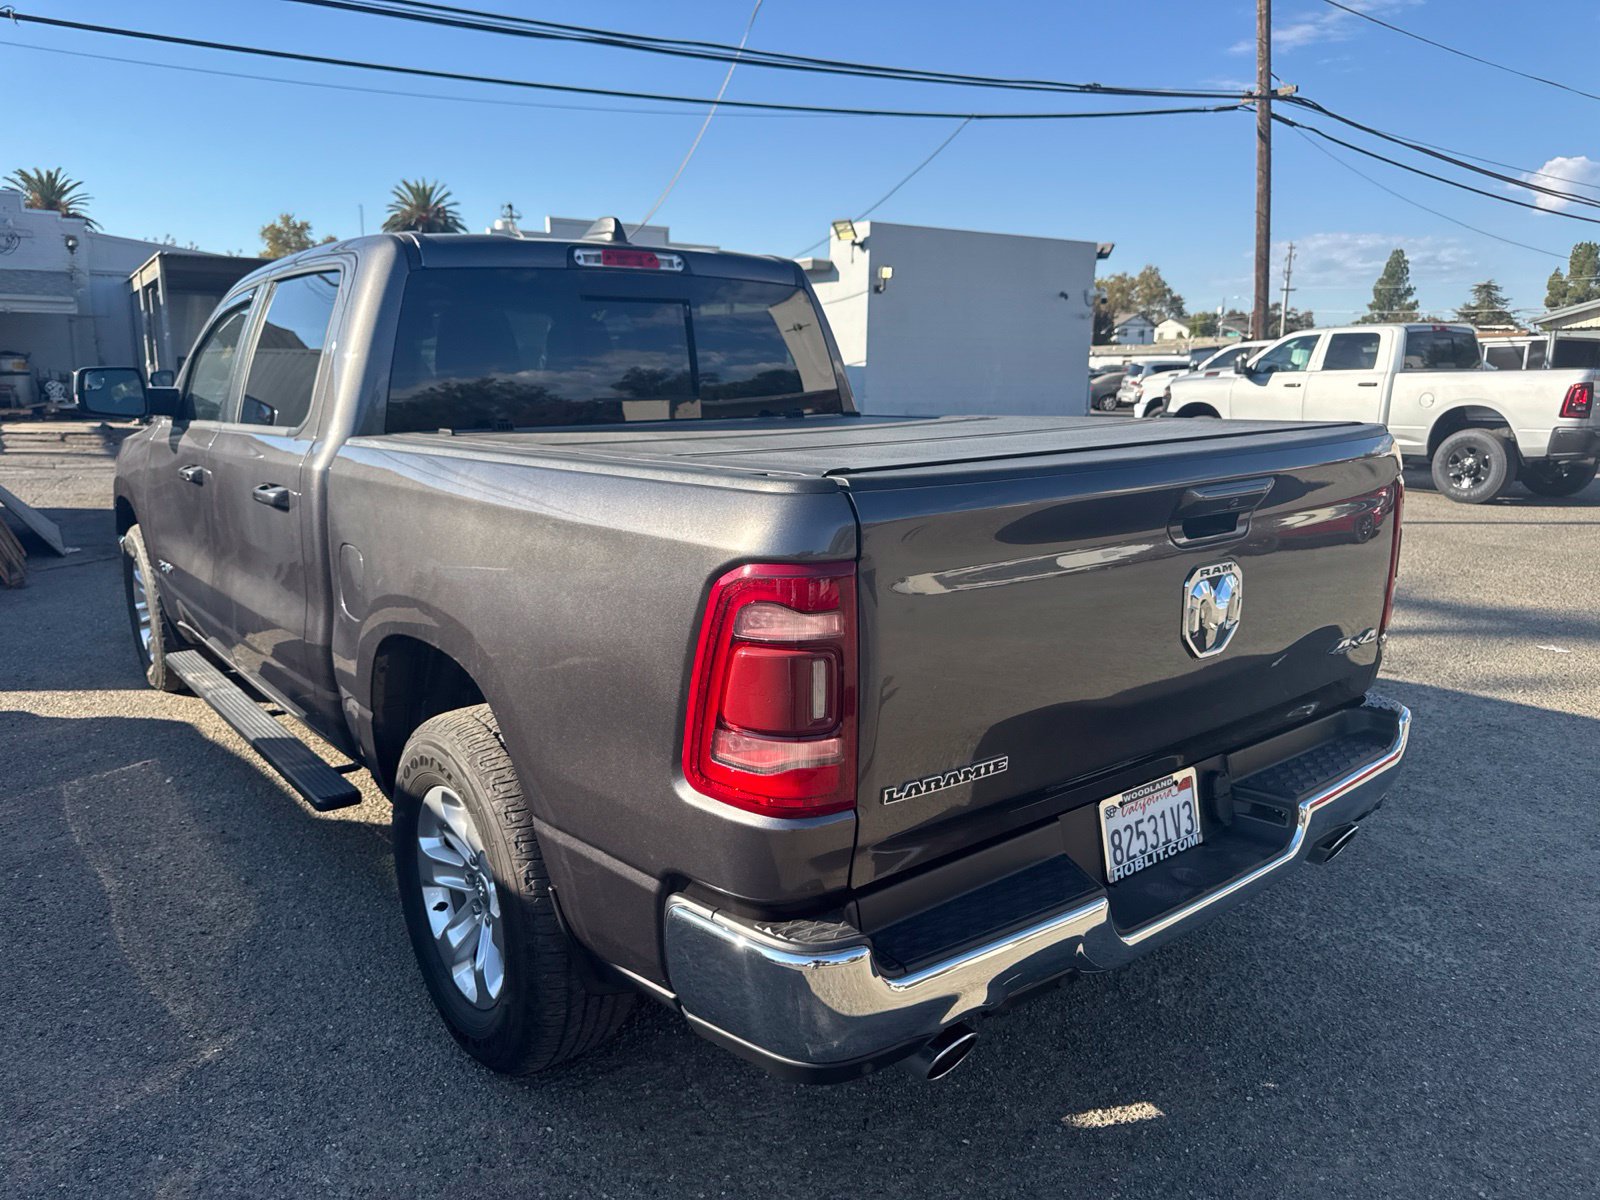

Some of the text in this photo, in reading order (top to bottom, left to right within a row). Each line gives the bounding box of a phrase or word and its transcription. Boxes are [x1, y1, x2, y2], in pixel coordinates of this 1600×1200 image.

[1199, 563, 1233, 577] RAM
[882, 756, 1009, 805] LARAMIE
[1123, 778, 1174, 803] WOODLAND
[1105, 806, 1118, 820] SEP
[1121, 788, 1179, 818] California
[1110, 801, 1195, 865] 82531V3
[1113, 834, 1199, 882] HOBLIT.COM
